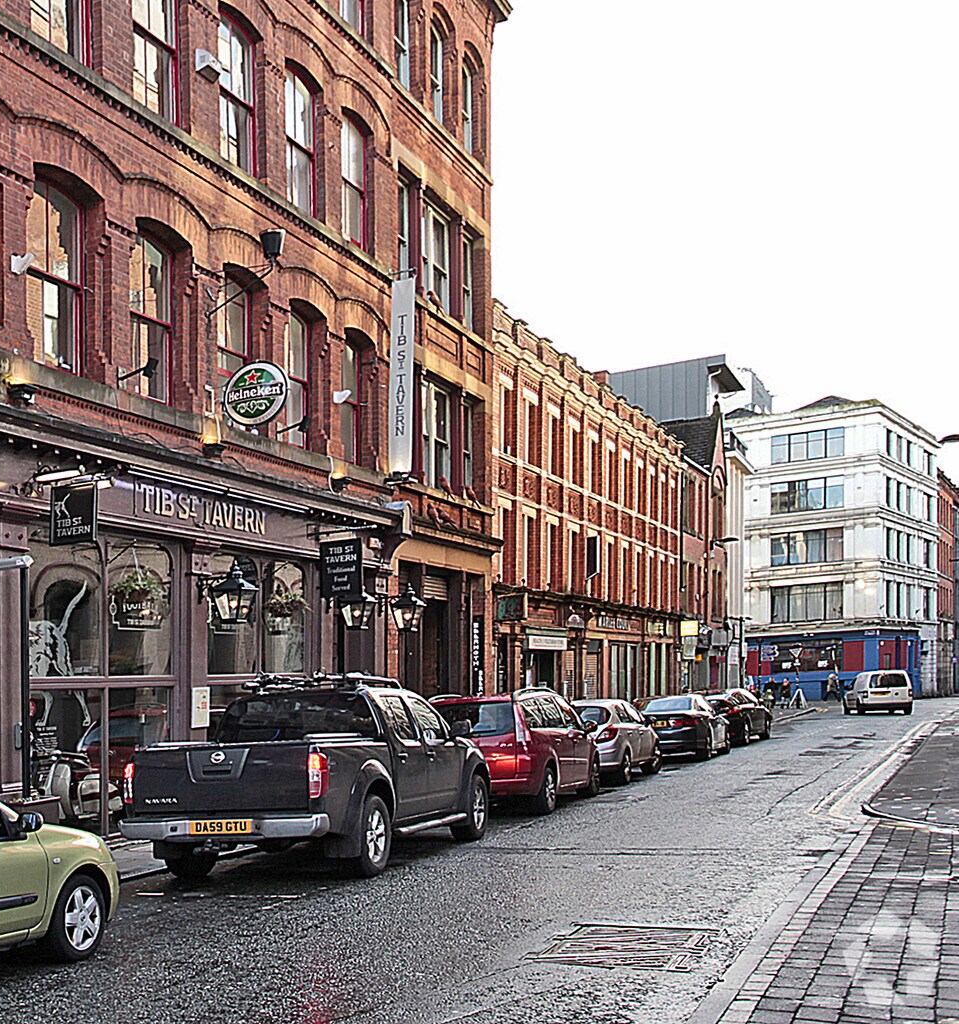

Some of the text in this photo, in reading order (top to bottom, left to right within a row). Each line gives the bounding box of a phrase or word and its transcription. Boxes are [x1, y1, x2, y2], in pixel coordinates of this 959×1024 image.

[397, 314, 407, 346] TIB
[228, 383, 281, 403] Heineken
[395, 373, 407, 436] TAVERN
[143, 486, 175, 517] TIB
[203, 499, 268, 535] TAVERN
[56, 518, 72, 528] TIB
[56, 525, 91, 538] TAVERN
[328, 546, 343, 555] TIB
[325, 554, 357, 564] TAVERN
[145, 797, 178, 805] NAVARA
[195, 820, 247, 833] DA59 GTU
